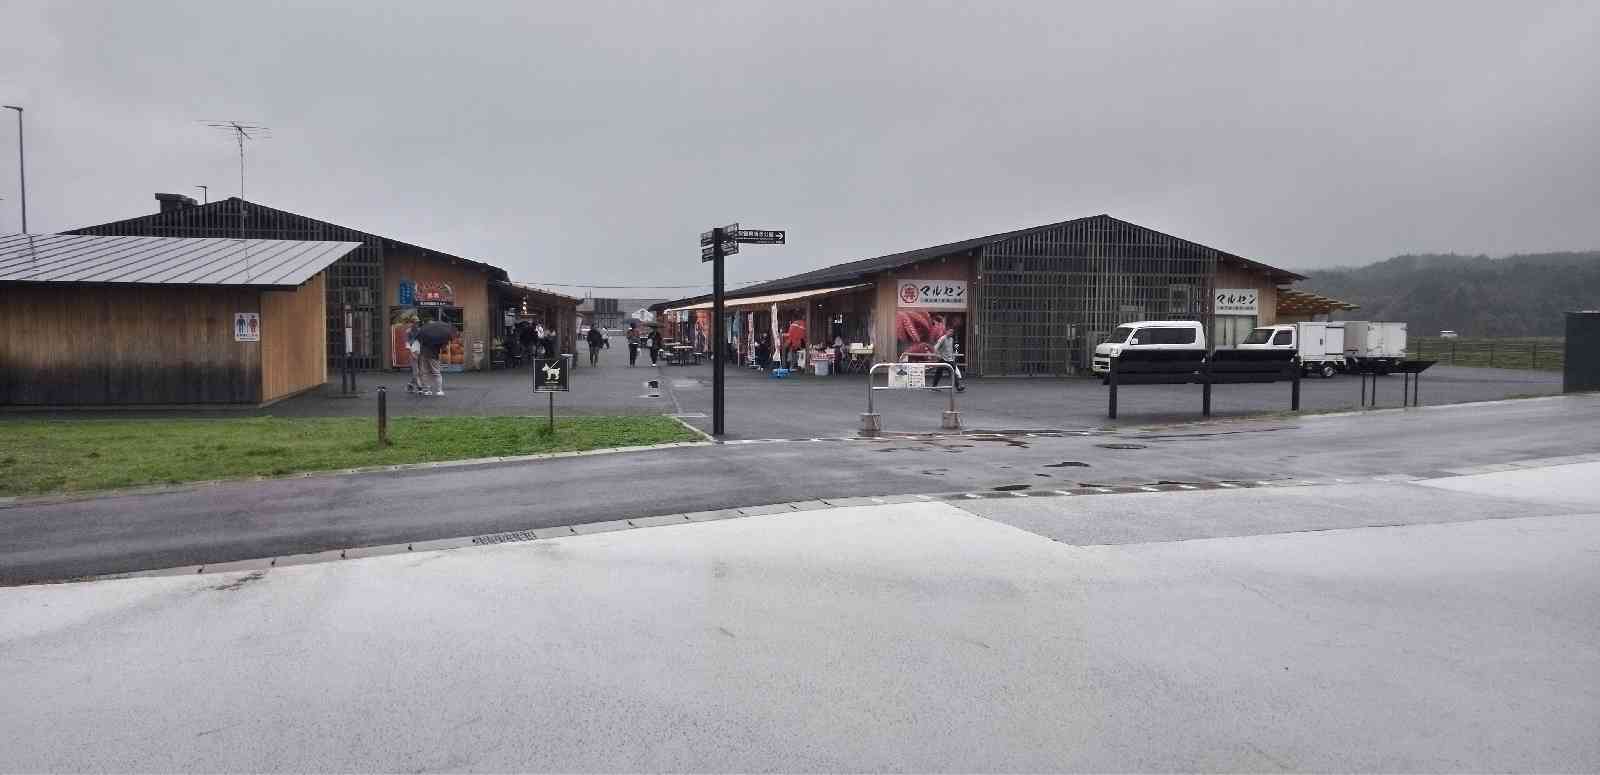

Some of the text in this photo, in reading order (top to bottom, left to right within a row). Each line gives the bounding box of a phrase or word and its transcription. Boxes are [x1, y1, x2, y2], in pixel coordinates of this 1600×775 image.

[920, 285, 965, 297] マルセン
[1217, 294, 1256, 304] マルセン
